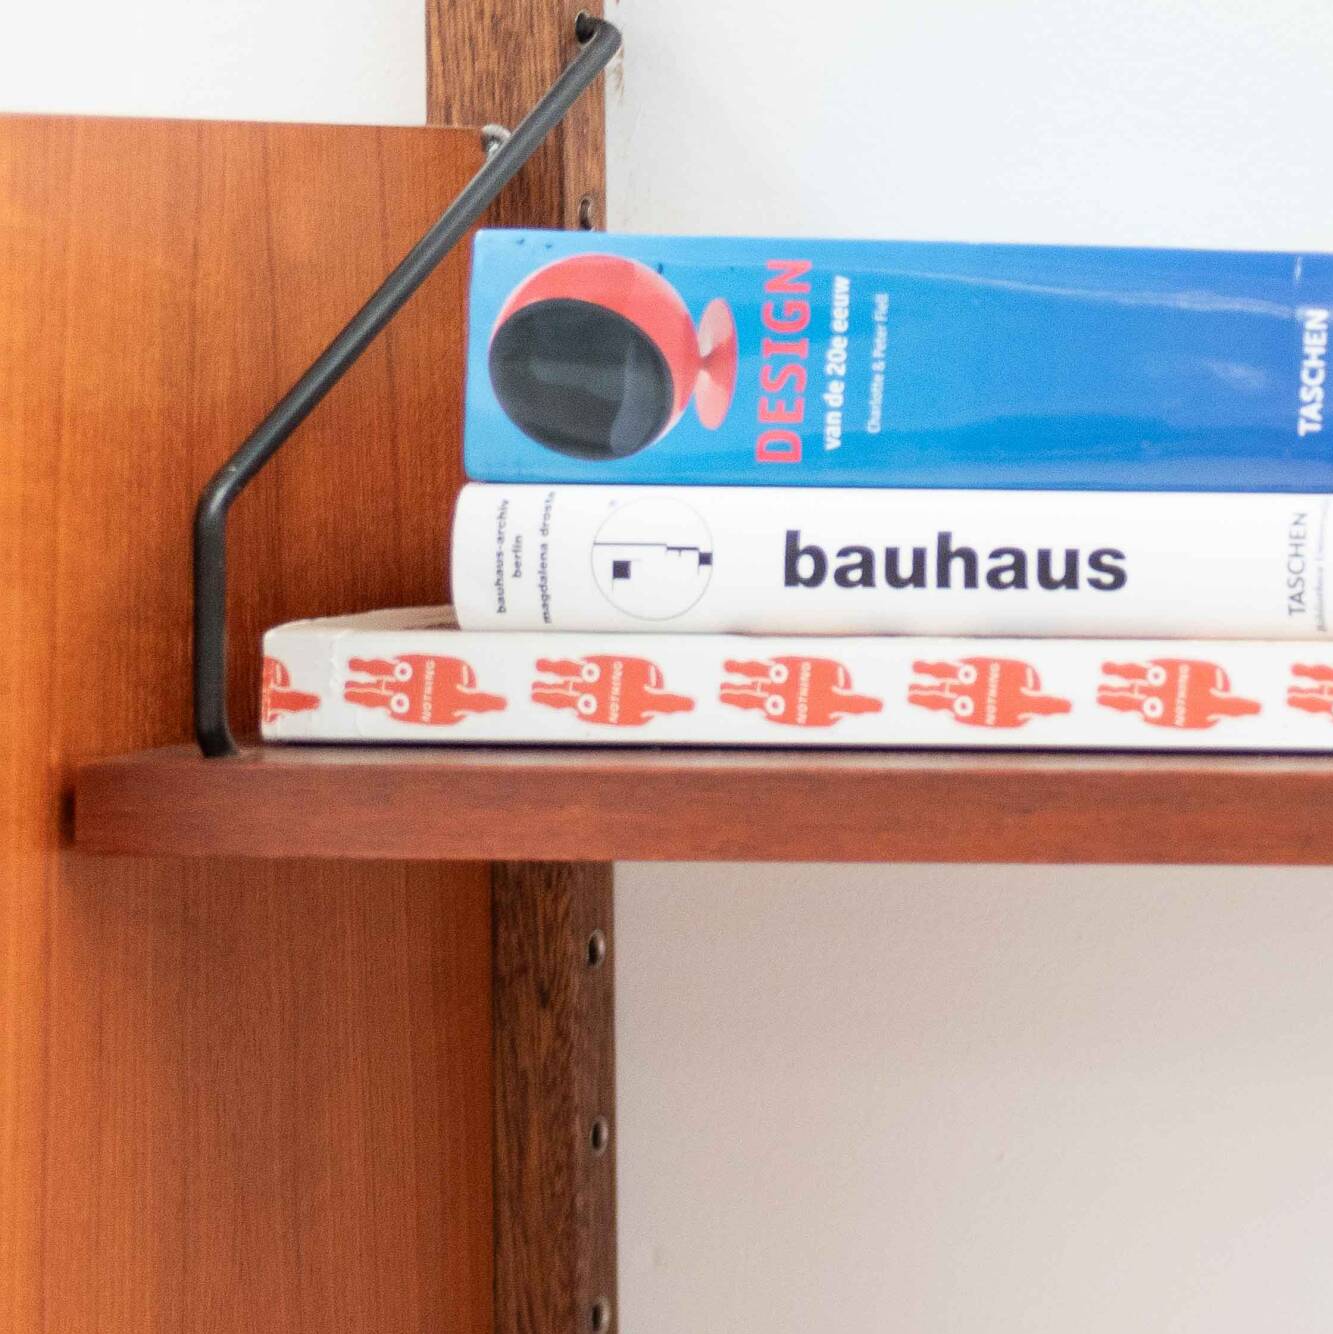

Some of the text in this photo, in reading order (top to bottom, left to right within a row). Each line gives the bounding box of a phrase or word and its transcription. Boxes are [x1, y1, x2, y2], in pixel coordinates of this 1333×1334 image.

[755, 259, 812, 463] DESIGN
[822, 275, 850, 450] van de 20e eeuw
[872, 324, 888, 358] Peter
[872, 361, 886, 371] &
[1298, 308, 1328, 436] TASCHEN
[867, 374, 884, 434] Charlotte
[494, 499, 509, 614] bauhaus-archiv
[512, 535, 523, 578] berlin
[538, 543, 552, 624] magdalena
[783, 529, 1127, 590] bauhaus
[1287, 513, 1308, 616] TASCHEN
